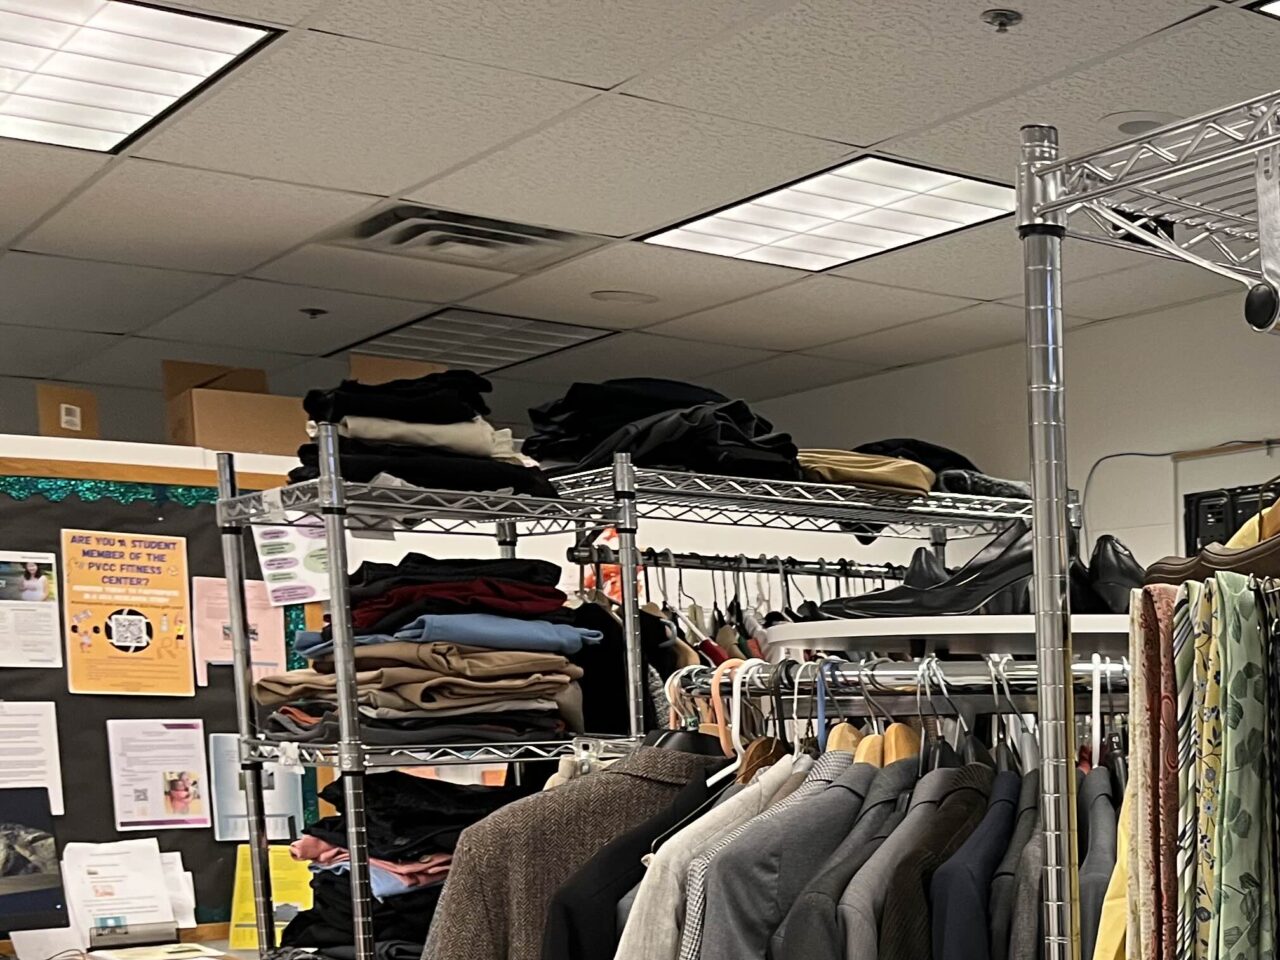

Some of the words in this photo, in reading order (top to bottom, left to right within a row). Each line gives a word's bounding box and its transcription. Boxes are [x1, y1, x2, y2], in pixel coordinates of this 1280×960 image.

[70, 535, 92, 545] ARE
[95, 537, 115, 546] YOU
[131, 539, 177, 550] STUDENT
[82, 549, 125, 559] MEMBER
[129, 552, 141, 561] OF
[146, 553, 167, 562] THE
[88, 562, 117, 572] PVCC
[120, 564, 162, 574] FITNESS
[101, 576, 150, 586] CENTER?
